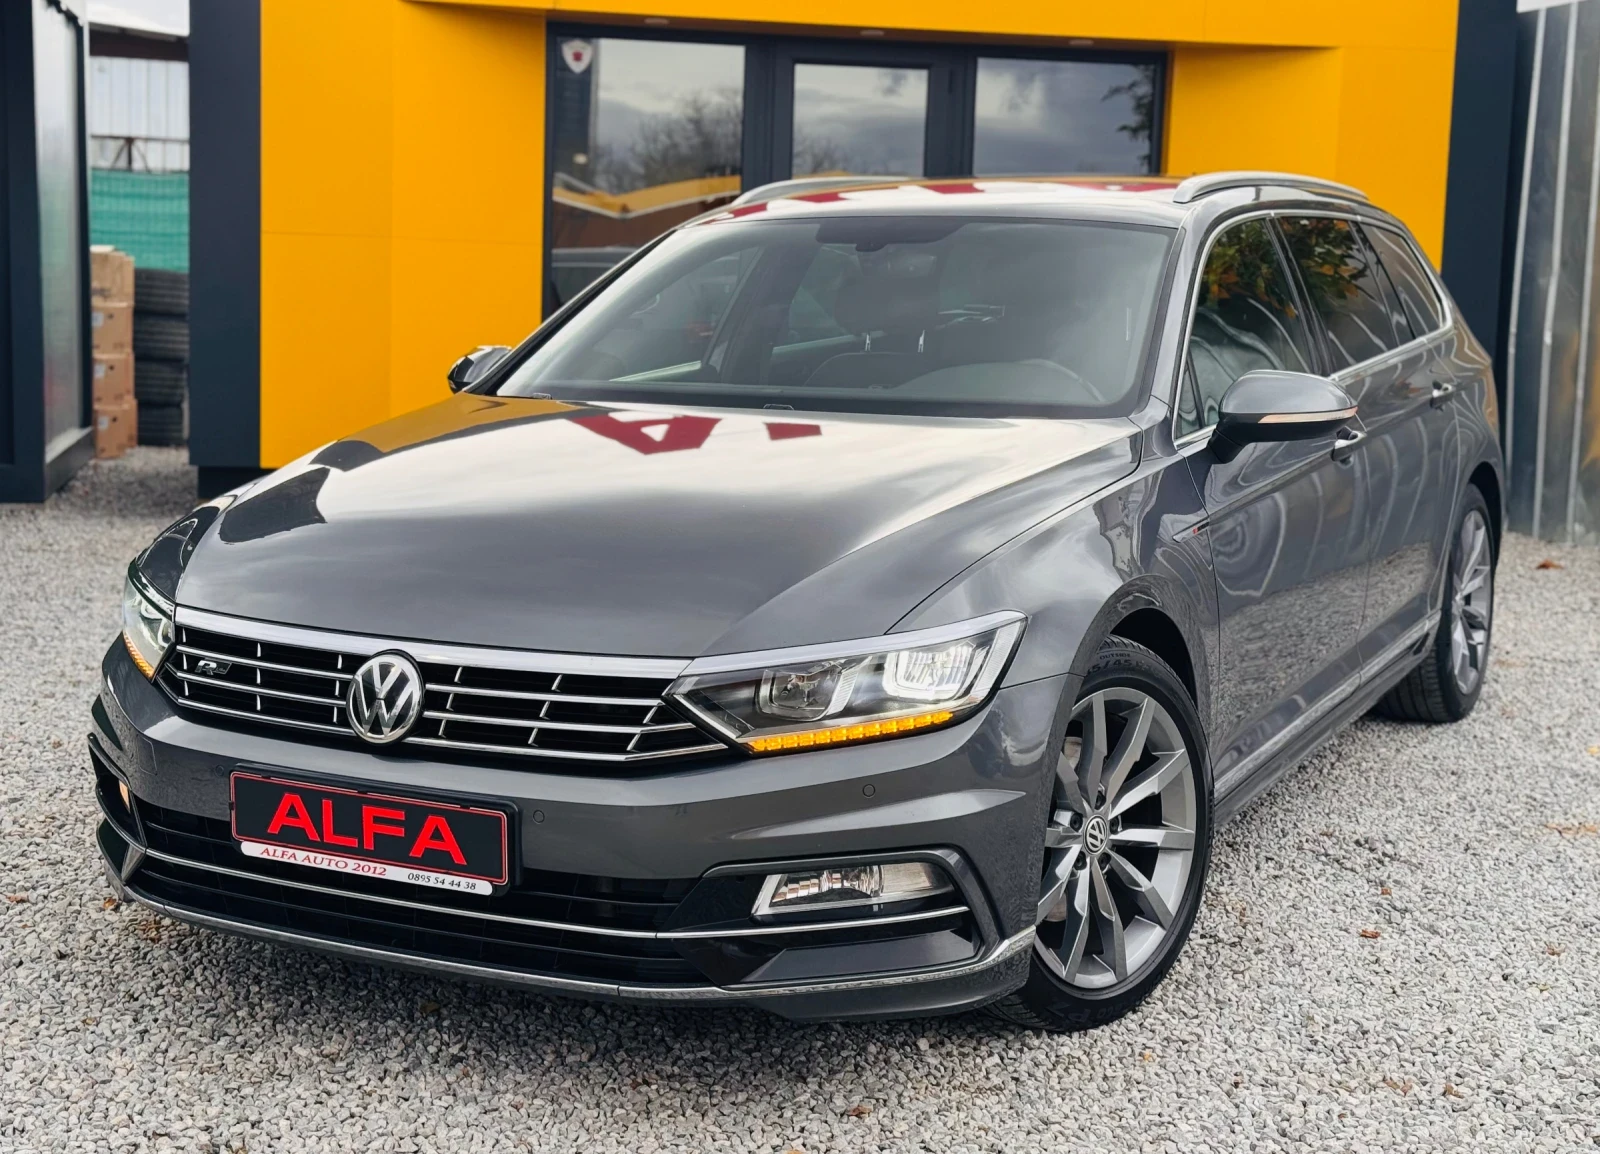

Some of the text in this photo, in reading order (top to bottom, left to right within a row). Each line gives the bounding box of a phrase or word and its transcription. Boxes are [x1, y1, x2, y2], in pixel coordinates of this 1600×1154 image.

[350, 655, 420, 740] VW
[267, 793, 467, 866] ALFA
[260, 847, 387, 877] ALFA AUTO 2012
[407, 872, 477, 891] 0895 54 44 38
